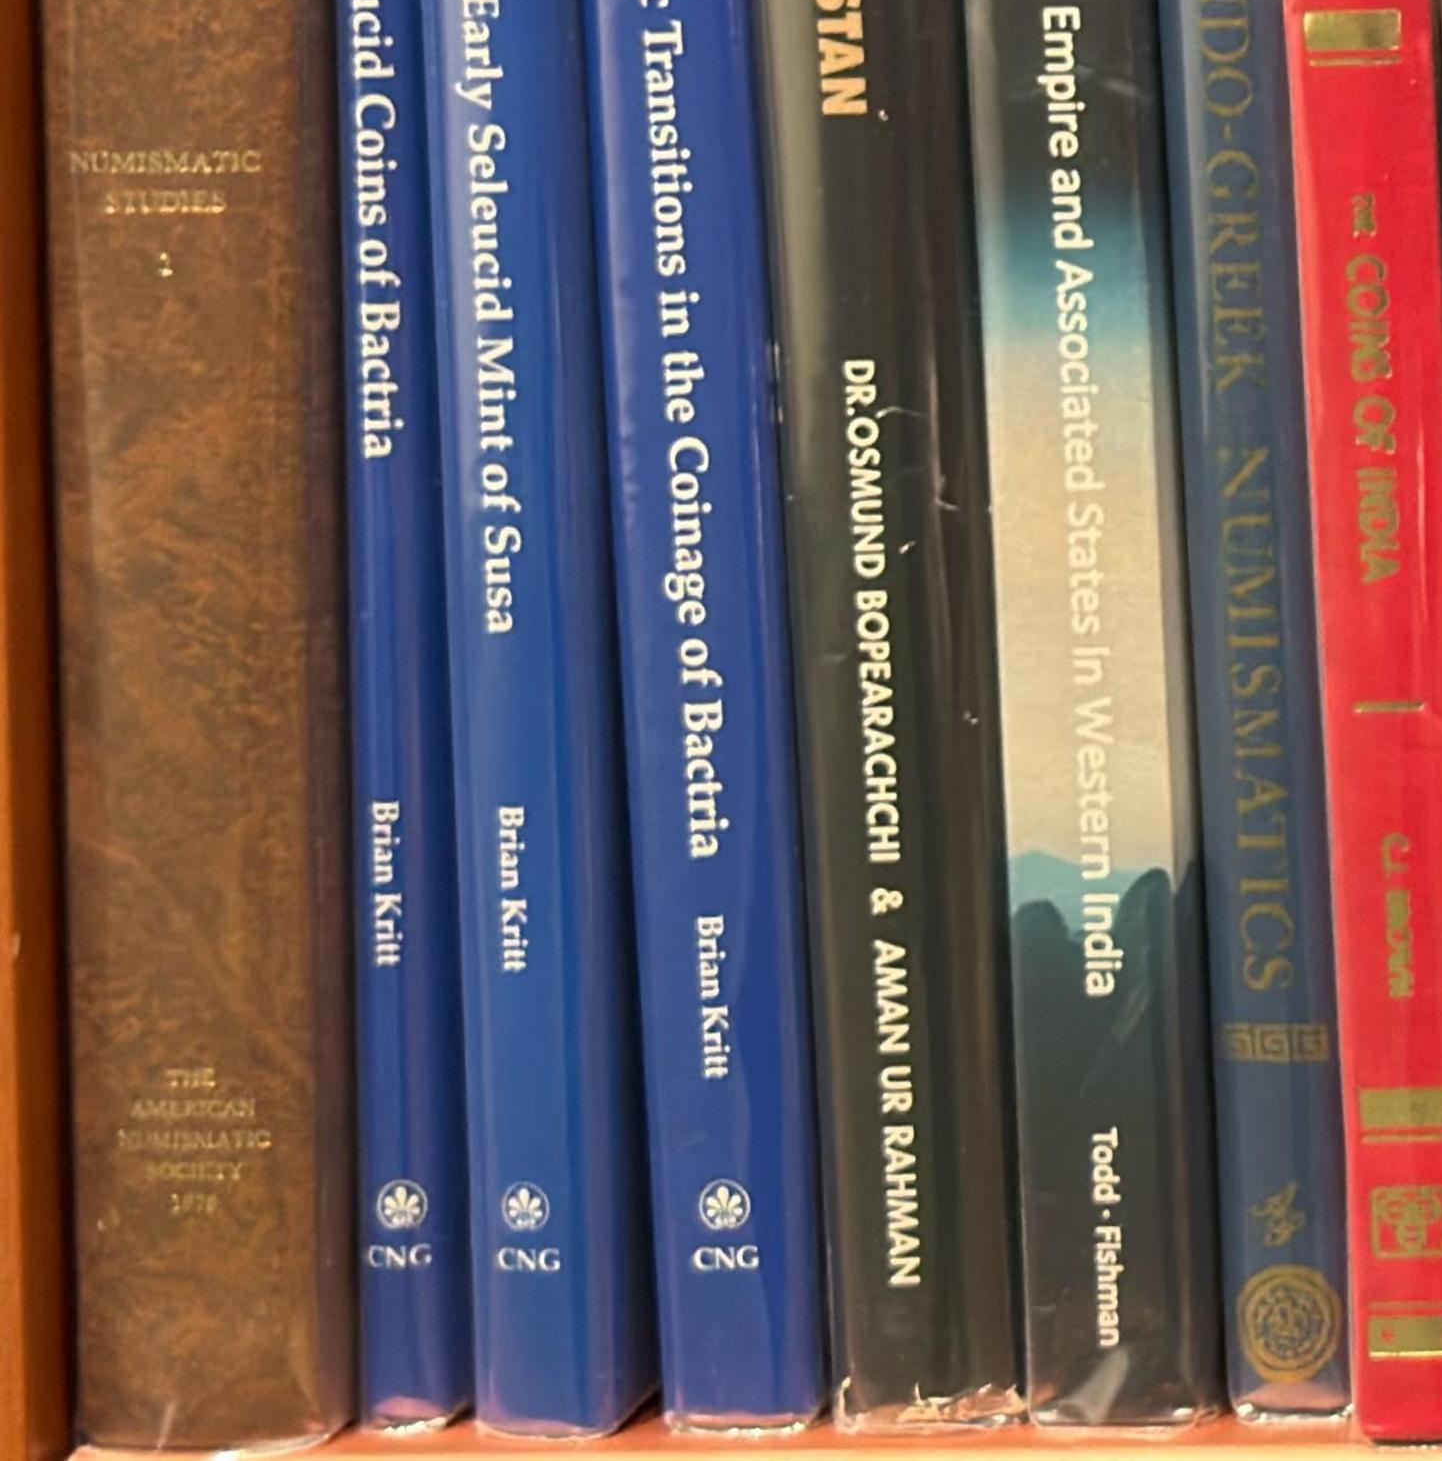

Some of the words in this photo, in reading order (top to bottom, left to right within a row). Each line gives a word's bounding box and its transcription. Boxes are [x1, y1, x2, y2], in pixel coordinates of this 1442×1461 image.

[1038, 6, 1085, 158] Empire
[70, 150, 263, 174] NUMISMATIC
[354, 94, 398, 228] Coins
[642, 19, 693, 278] Transitions
[106, 190, 227, 214] STUDIES
[467, 123, 514, 322] Seleucid
[1050, 169, 1094, 250] and
[359, 240, 401, 287] of
[661, 291, 701, 337] in
[1346, 254, 1392, 381] COINS
[360, 302, 404, 459] Bactria
[476, 337, 517, 450] Mint
[662, 351, 704, 424] the
[1055, 260, 1105, 493] Associated
[1353, 395, 1396, 454] OF
[481, 463, 520, 513] of
[664, 435, 712, 626] Coinage
[1355, 468, 1400, 584] INDIA
[483, 525, 522, 635] Susa
[1067, 502, 1104, 635] States
[679, 639, 723, 686] of
[855, 590, 901, 862] BOPEARACHCHI
[1218, 446, 1295, 991] NUMISMATICS
[683, 699, 730, 860] Bactria
[1075, 697, 1114, 880] Western
[370, 800, 401, 885] Brian
[499, 806, 526, 889] Brian
[373, 893, 404, 966] Kritt
[501, 899, 529, 972] Kritt
[869, 887, 904, 914] &
[697, 914, 726, 999] Brian
[1082, 894, 1124, 997] India
[873, 940, 910, 1054] AMAN
[701, 1006, 730, 1079] Kritt
[880, 1067, 913, 1113] UR
[883, 1125, 921, 1287] RAHMAN
[1091, 1127, 1122, 1202] Todd
[368, 1243, 432, 1269] CNG
[497, 1248, 560, 1272] CNG
[693, 1245, 759, 1269] CNG
[1094, 1226, 1124, 1346] Fishman
